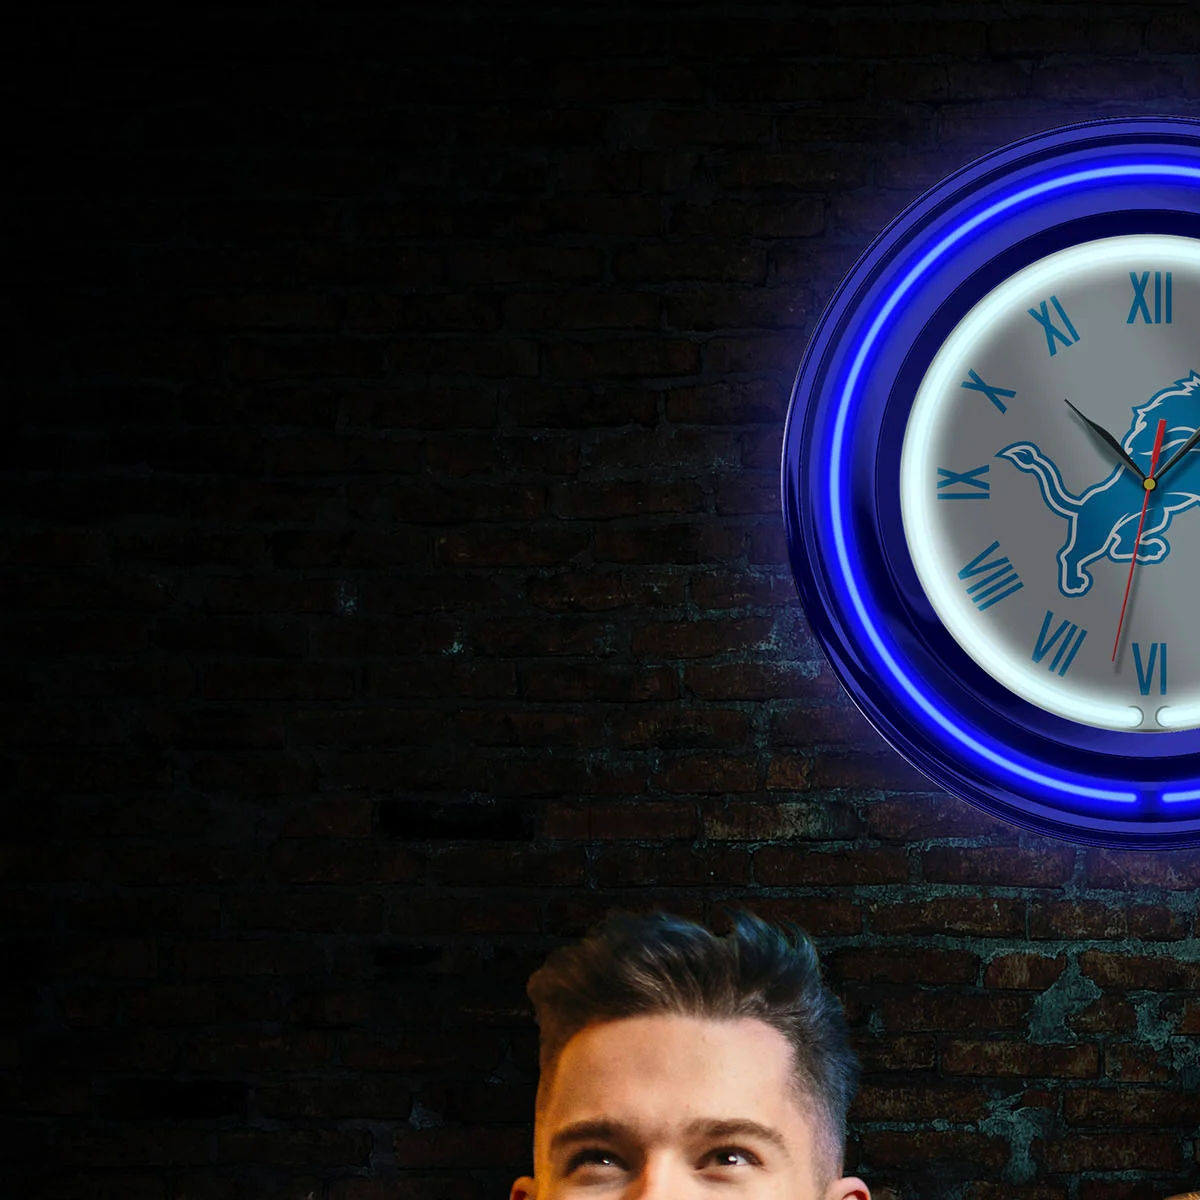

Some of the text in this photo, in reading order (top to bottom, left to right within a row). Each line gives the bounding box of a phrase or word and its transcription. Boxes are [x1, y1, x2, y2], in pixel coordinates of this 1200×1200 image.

[1126, 271, 1173, 324] XII
[1027, 295, 1081, 357] XI
[961, 368, 1017, 415] X
[937, 464, 991, 501] IX
[957, 540, 1025, 612] VIII
[1031, 610, 1088, 677] VII
[1131, 642, 1167, 696] VI
